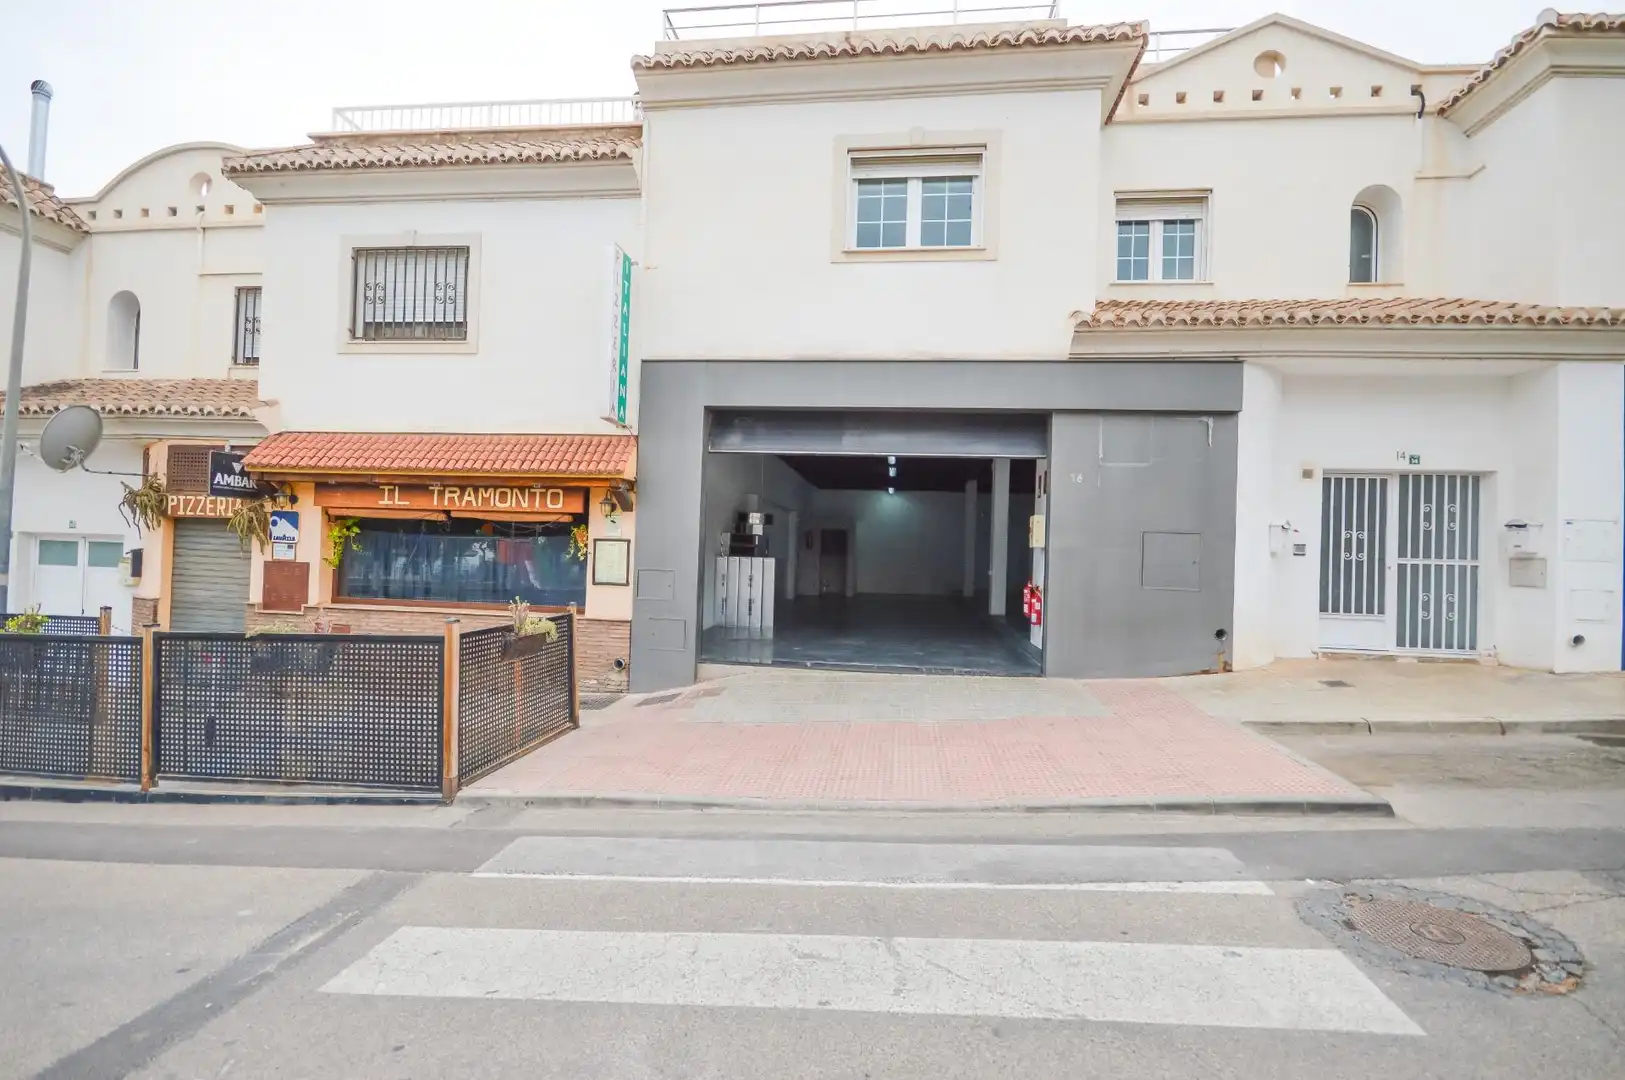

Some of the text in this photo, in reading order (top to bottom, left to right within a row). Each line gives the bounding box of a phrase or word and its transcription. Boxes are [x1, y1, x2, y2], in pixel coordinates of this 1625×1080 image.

[619, 261, 629, 417] ITALIANA
[1396, 451, 1405, 461] 14
[1070, 473, 1083, 484] 16
[378, 485, 563, 508] IL TRAMONTO
